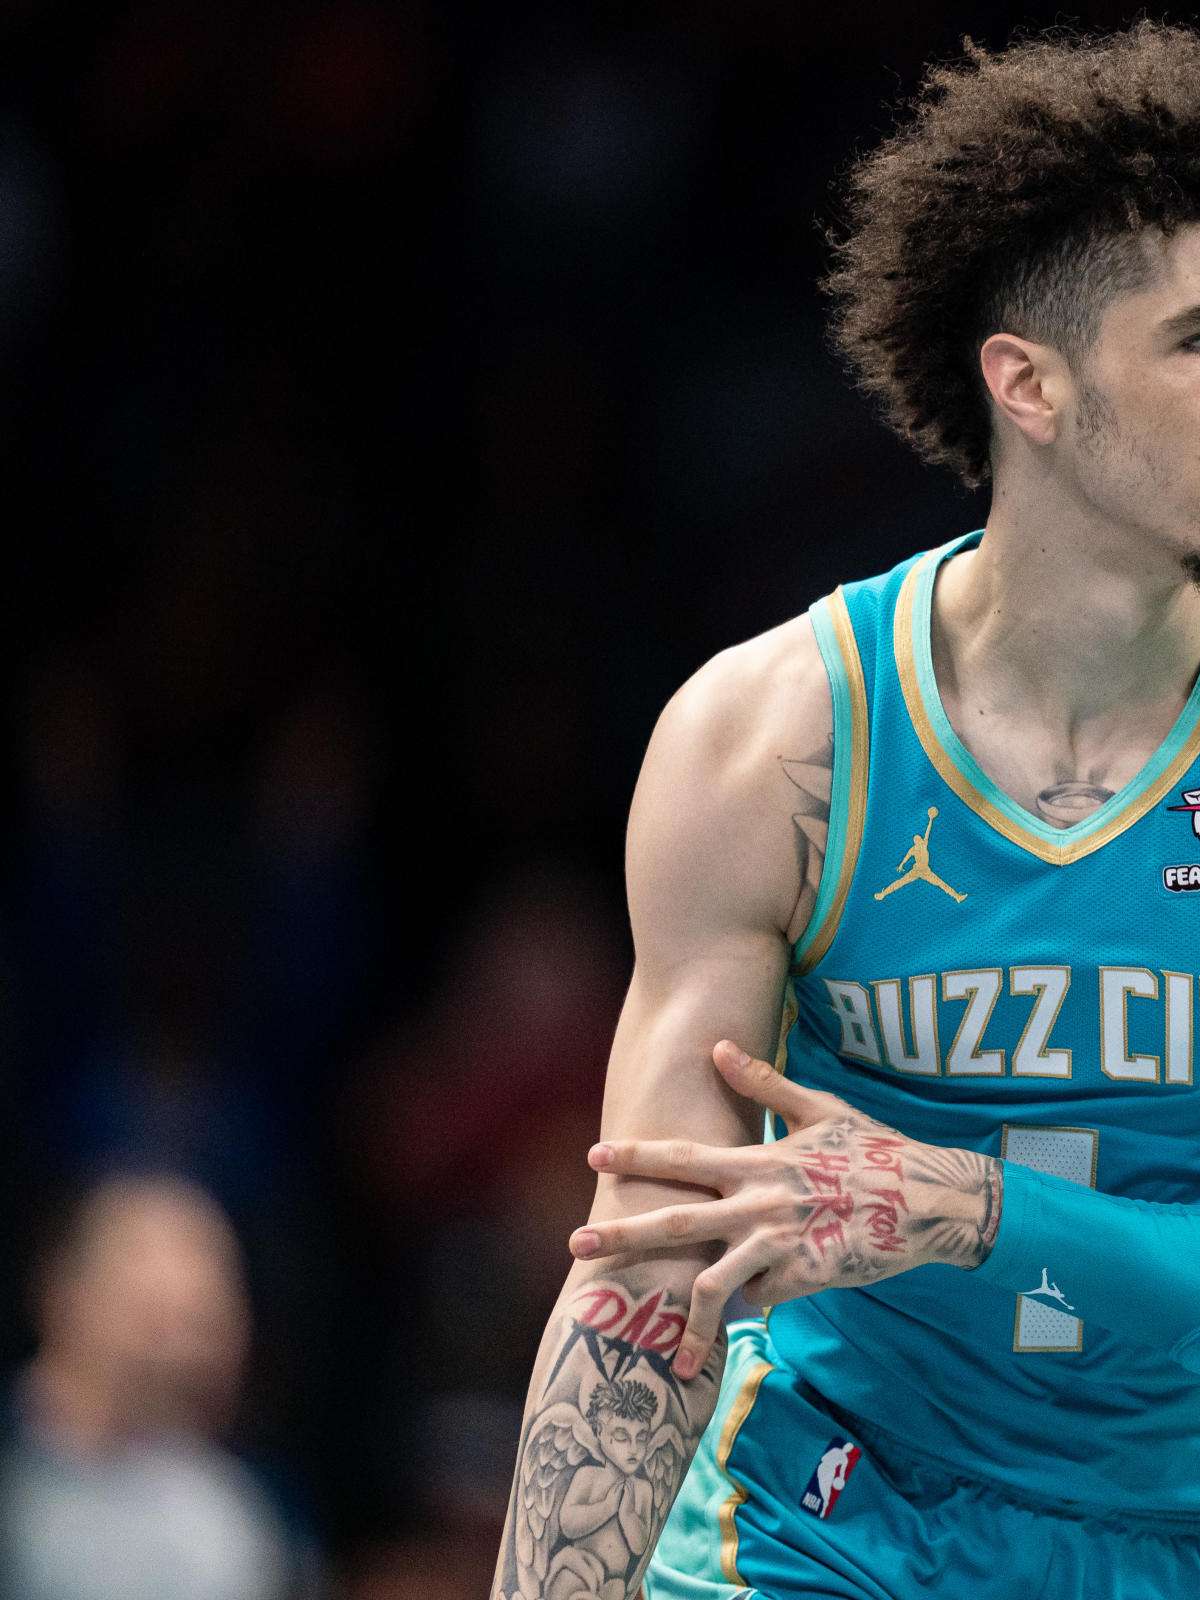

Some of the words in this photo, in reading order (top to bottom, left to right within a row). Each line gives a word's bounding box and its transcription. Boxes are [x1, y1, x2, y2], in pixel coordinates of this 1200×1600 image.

[825, 965, 1073, 1079] BUZZ
[856, 1134, 907, 1183] NOT
[800, 1151, 854, 1259] HERE
[862, 1188, 910, 1253] FROM
[576, 1288, 687, 1353] DAD
[802, 1492, 821, 1512] NBA
